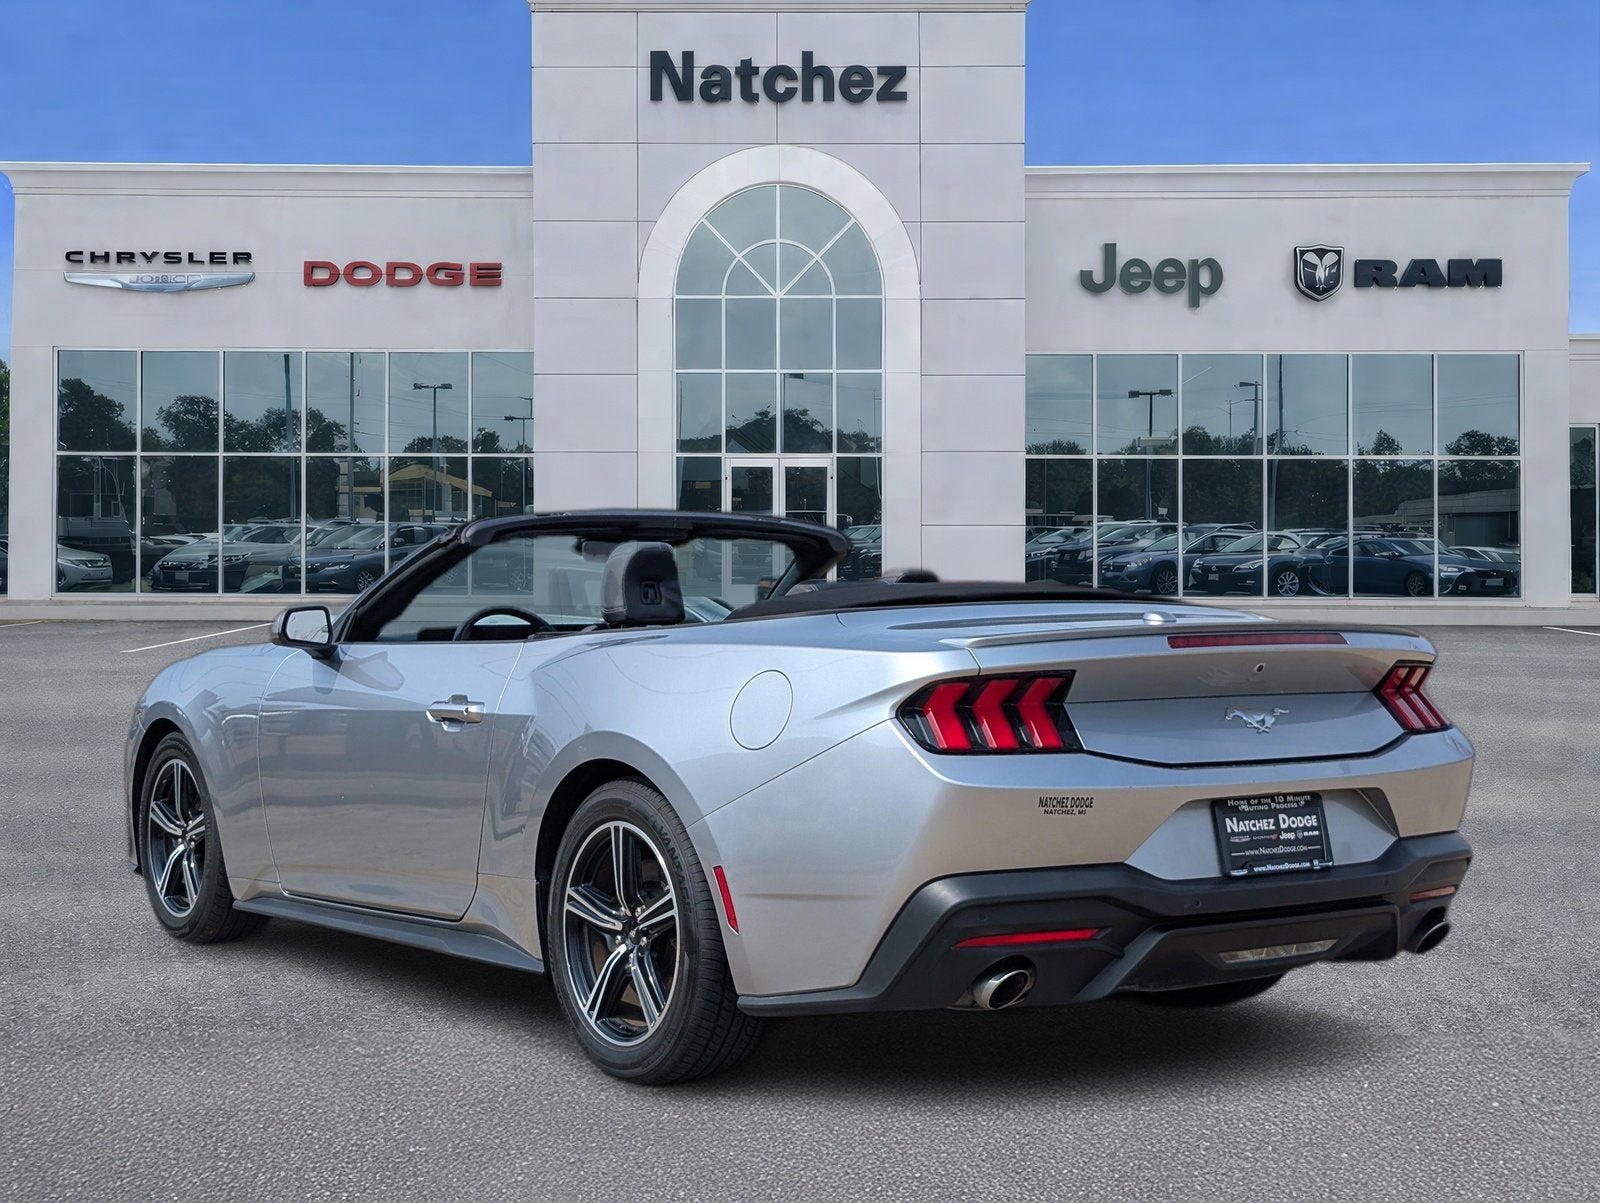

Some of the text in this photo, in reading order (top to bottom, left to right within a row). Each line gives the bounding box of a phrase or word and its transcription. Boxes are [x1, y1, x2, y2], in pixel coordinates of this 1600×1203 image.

[650, 50, 907, 104] Natchez
[65, 250, 252, 265] CHRYSLER
[303, 260, 502, 287] DODGE
[1080, 243, 1223, 308] Jeep
[1354, 258, 1503, 288] RAM
[1038, 796, 1094, 808] NATCHEZ DODGE
[1274, 795, 1284, 803] 10
[1280, 831, 1296, 840] Jeep
